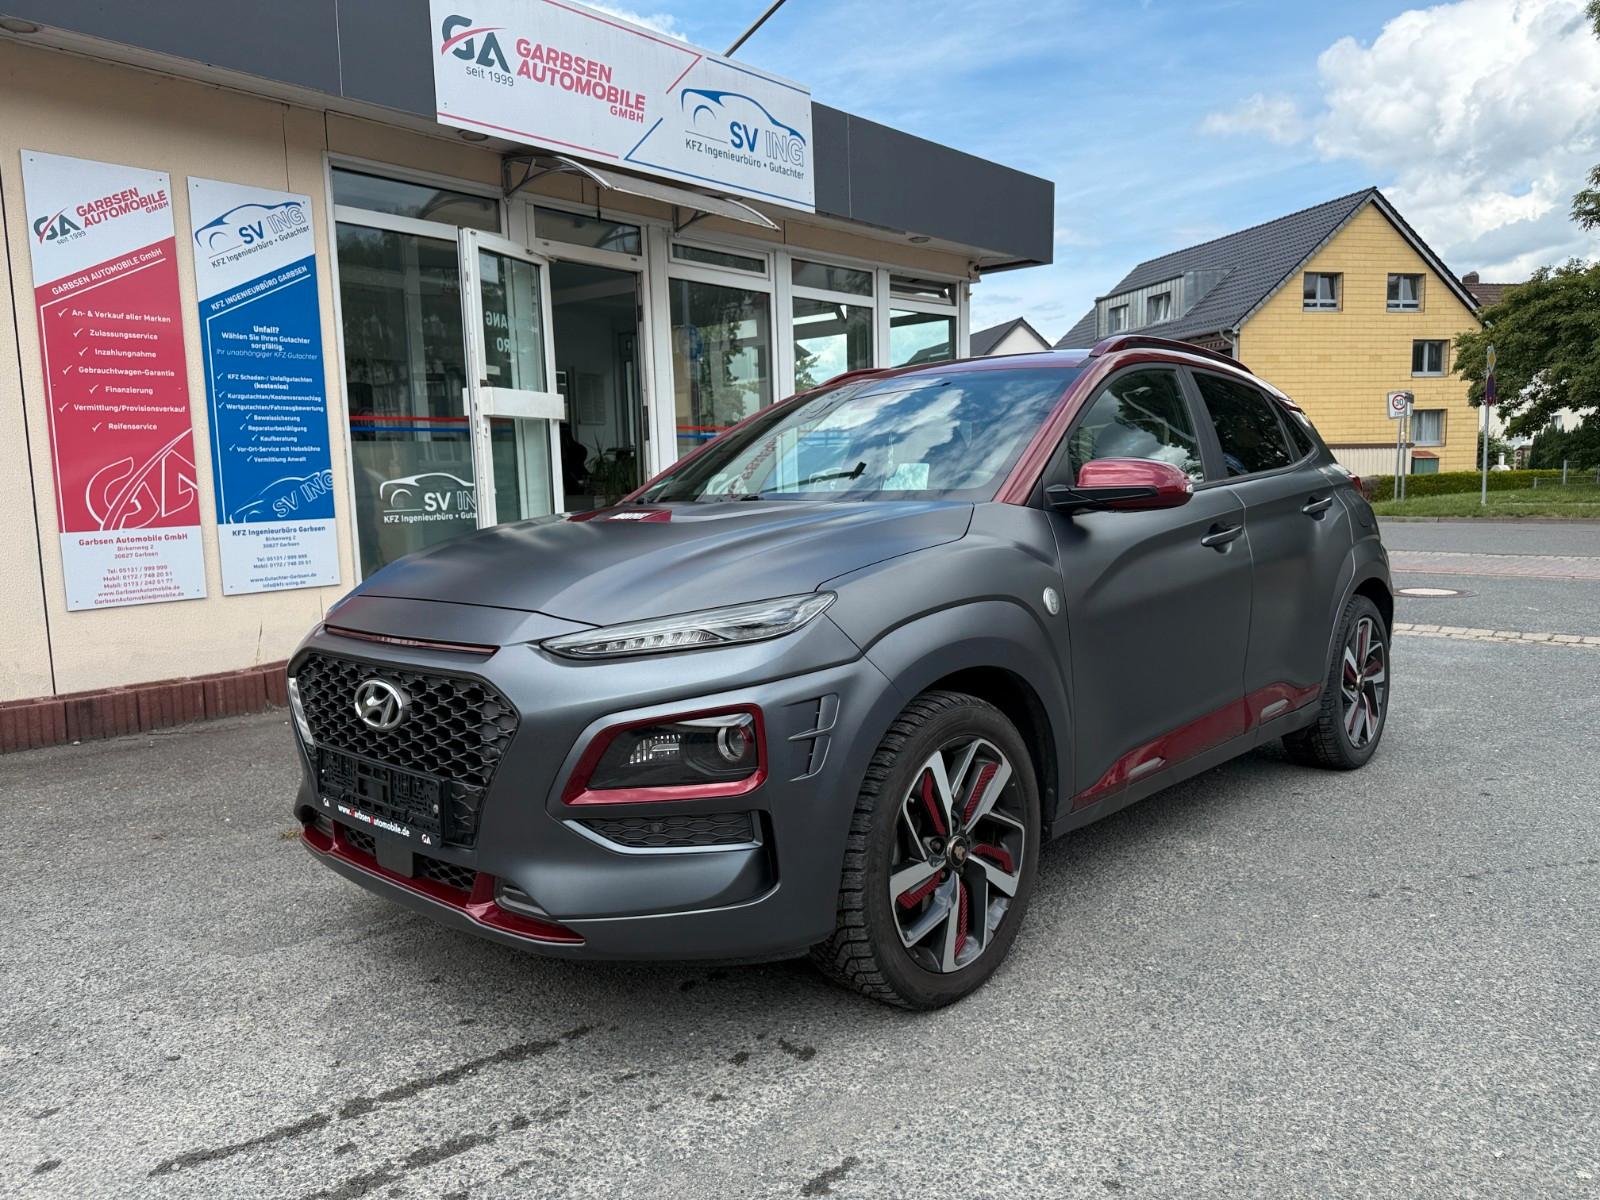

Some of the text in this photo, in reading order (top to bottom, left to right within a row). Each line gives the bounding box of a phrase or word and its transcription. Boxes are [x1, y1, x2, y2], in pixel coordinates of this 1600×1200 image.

[516, 38, 612, 83] GARBSEN
[465, 65, 514, 87] seit 1999
[516, 59, 646, 112] AUTOMOBILE
[610, 105, 644, 123] GMBH
[730, 120, 804, 167] SV ING
[685, 138, 804, 180] KFZ Ingenieurbüro Gutachter
[76, 187, 139, 217] GARBSEN
[84, 190, 167, 228] AUTOMOBILE
[145, 201, 169, 214] GMBH
[239, 207, 306, 245] SV ING
[56, 230, 86, 245] seit 1999
[211, 224, 310, 269] KFZ Ingenieurbüro Gutachter
[52, 248, 163, 295] GARBSEN AUTOMOBILE GmbH
[210, 265, 307, 311] KFZ INGENIEURBÜRO GARBSEN
[72, 309, 85, 317] An-
[95, 310, 124, 320] Verkauf
[125, 312, 142, 321] aller
[144, 314, 171, 323] Marken
[89, 329, 158, 340] Zulassungsservice
[253, 325, 279, 334] Unfall?
[221, 331, 248, 340] Wählen
[260, 334, 278, 342] Ihren
[279, 336, 310, 344] Gutachter
[95, 348, 157, 358] Inzahlungnahme
[226, 348, 272, 358] unabhängiger
[78, 366, 175, 377] Gebrauchtwagen-Garantie
[253, 382, 289, 390] (kostenlos)
[270, 375, 312, 383] Unfallgutachten
[105, 386, 153, 395] Finanzierung
[74, 403, 186, 413] Vermittlung/Provisionsverkauf
[108, 422, 157, 430] Reifenservice
[272, 490, 299, 518] SV
[424, 490, 477, 511] SV IN
[384, 515, 400, 523] KFZ
[401, 513, 453, 523] Ingenieurbüro
[248, 527, 298, 537] Ingenieurbüro
[78, 533, 188, 546] Garbsen Automobile GmbH
